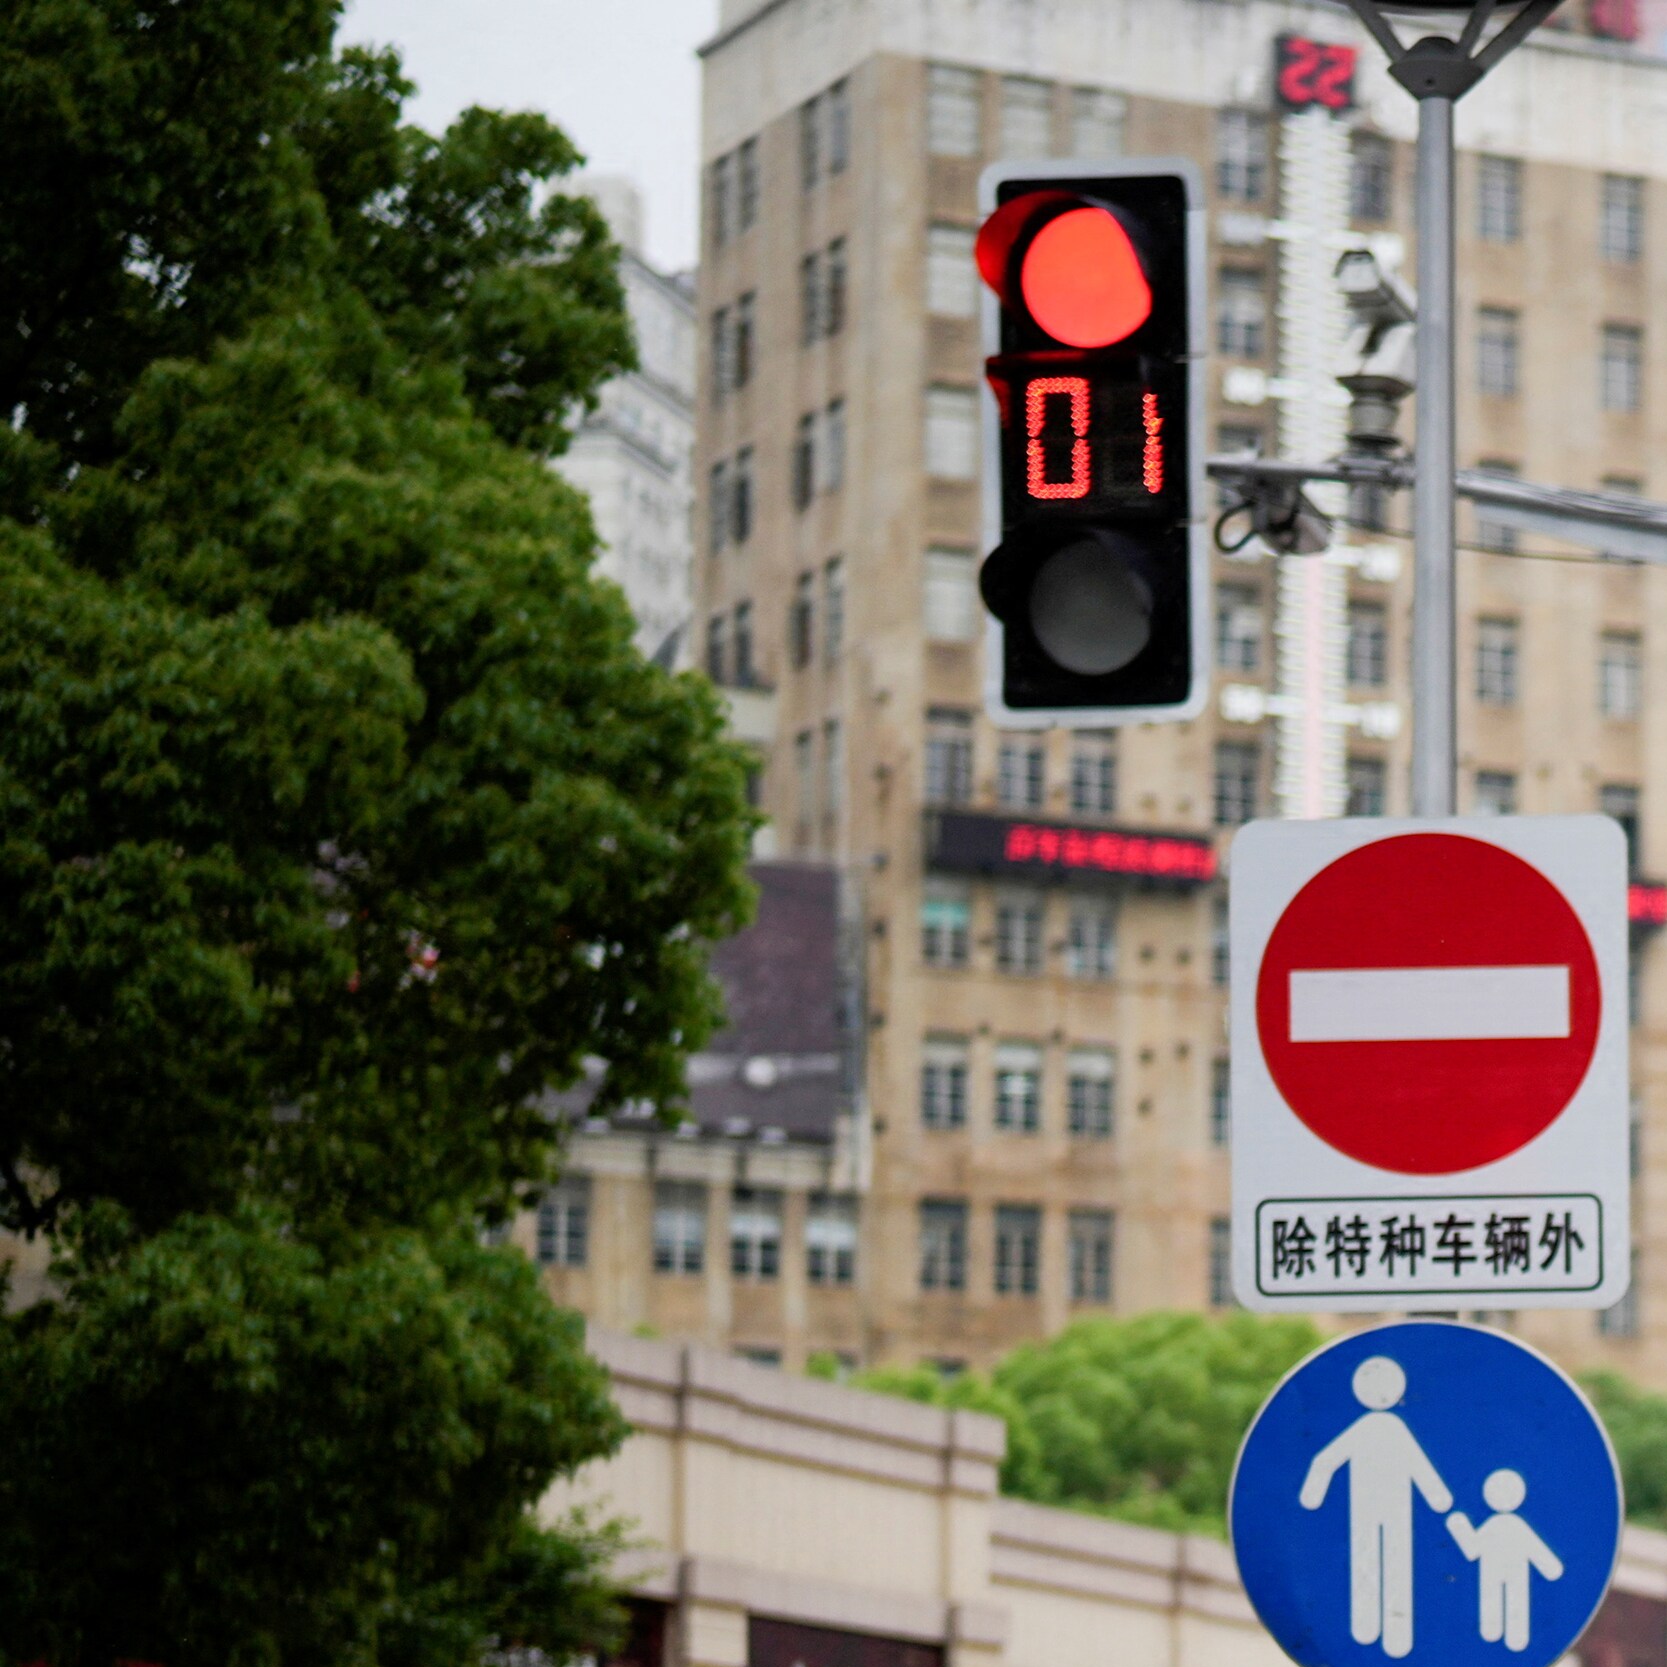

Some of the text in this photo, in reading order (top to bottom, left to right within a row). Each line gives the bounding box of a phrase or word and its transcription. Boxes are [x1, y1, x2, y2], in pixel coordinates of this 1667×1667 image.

[1026, 376, 1163, 498] 01
[1272, 1211, 1585, 1280] 除特种车辆外
